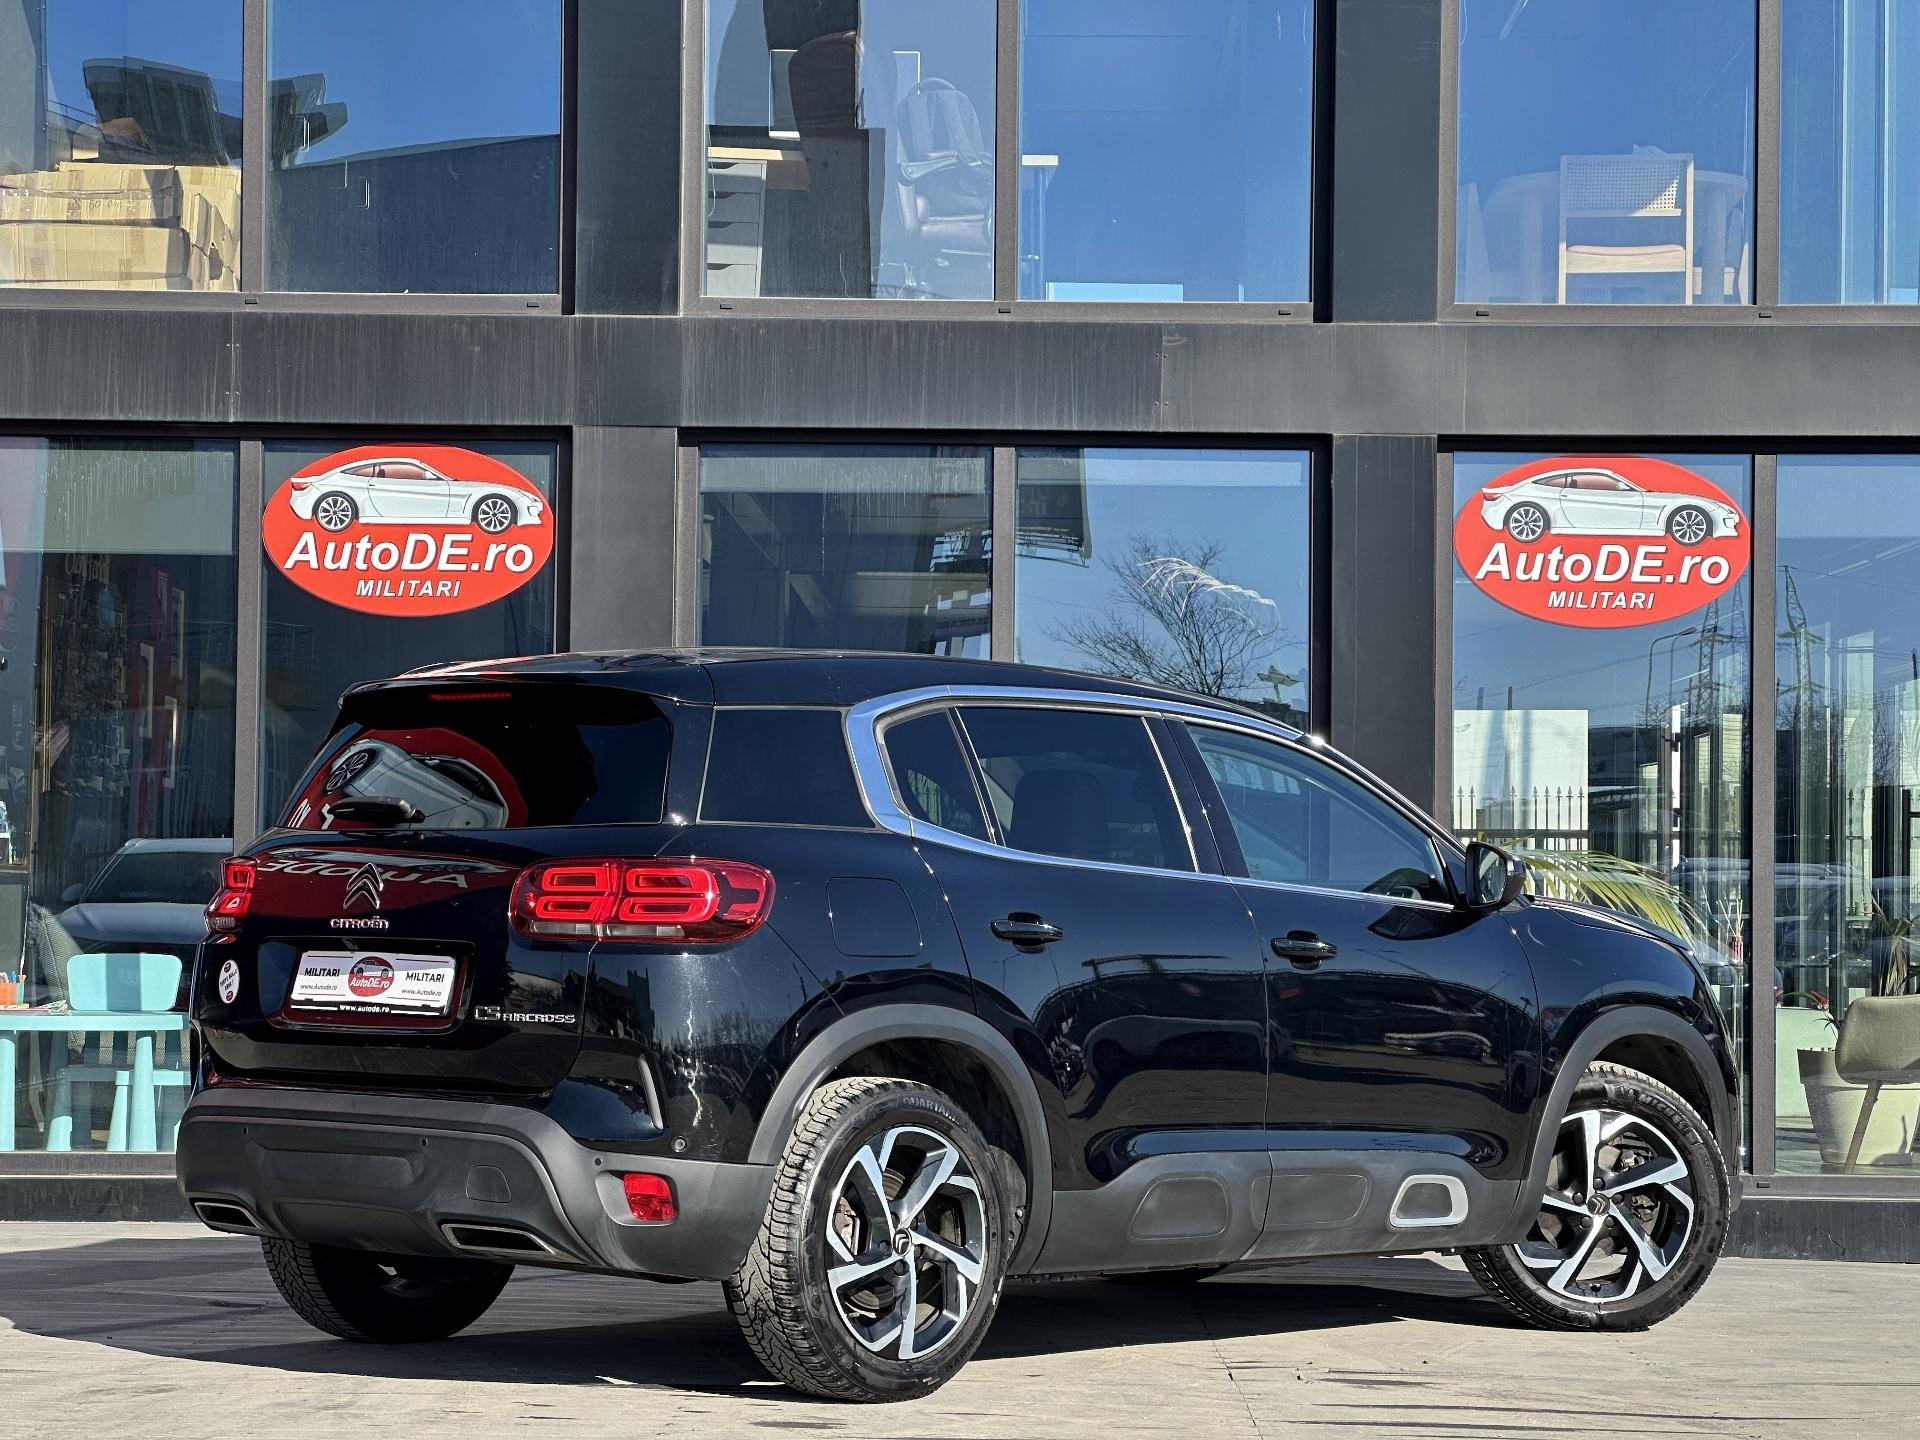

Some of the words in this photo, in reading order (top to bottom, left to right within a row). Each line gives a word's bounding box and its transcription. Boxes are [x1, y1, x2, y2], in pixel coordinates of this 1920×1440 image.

[283, 531, 533, 573] AutoDE.ro
[1475, 542, 1730, 584] AutoDE.ro
[355, 579, 461, 597] MILITARI
[1547, 591, 1654, 609] MILITARI
[304, 967, 340, 977] MILITARI
[405, 972, 445, 983] MILITARI
[350, 977, 390, 989] AutoDE.ro
[339, 1003, 390, 1013] www.autode.ro
